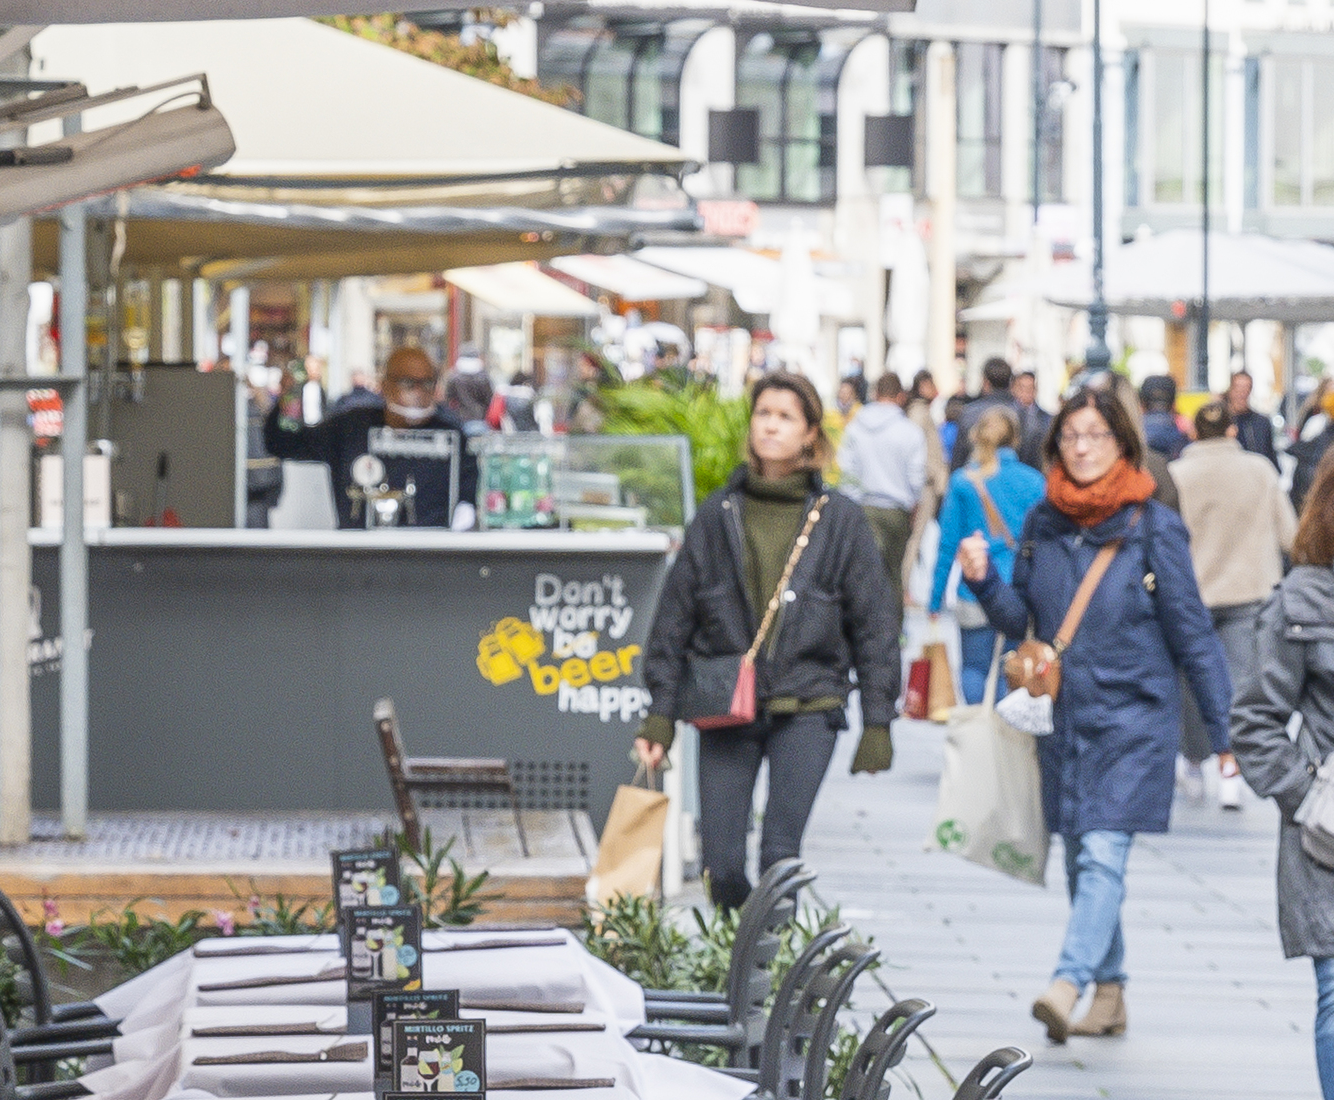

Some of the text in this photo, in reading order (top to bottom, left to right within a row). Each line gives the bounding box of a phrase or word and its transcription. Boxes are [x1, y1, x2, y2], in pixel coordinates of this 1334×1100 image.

[535, 573, 627, 606] Don't
[529, 605, 634, 639] worry
[528, 644, 641, 695] beer
[404, 1024, 475, 1033] MIRTILLO SPRITZ
